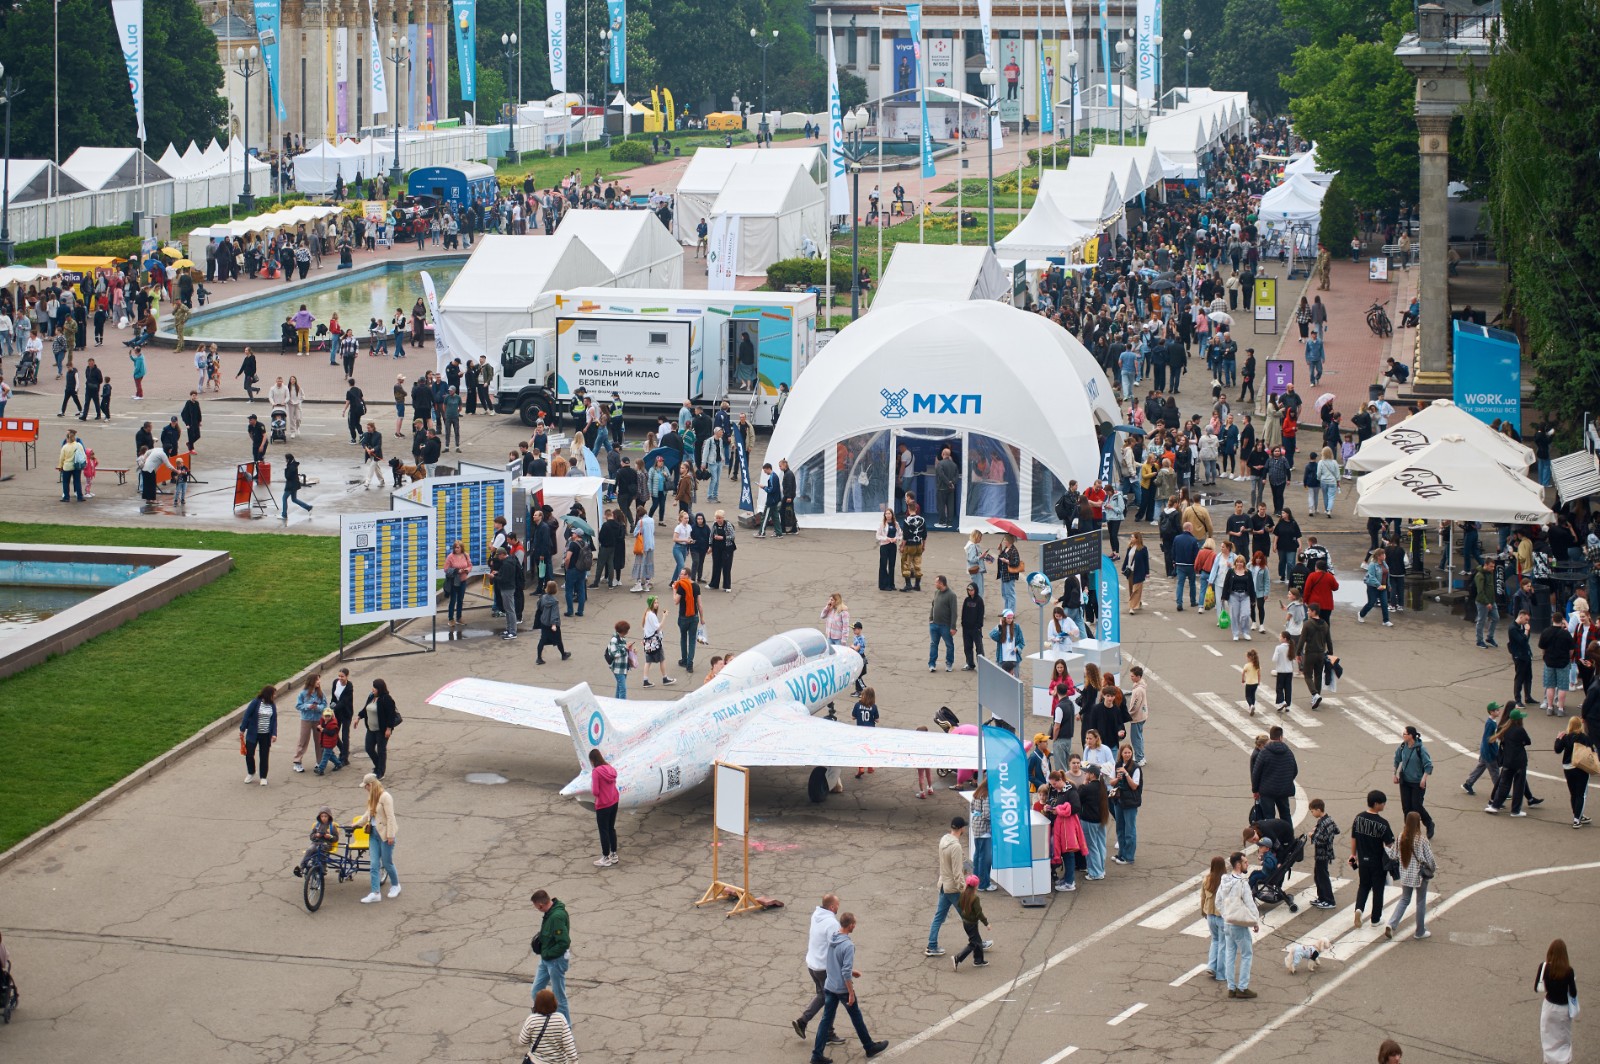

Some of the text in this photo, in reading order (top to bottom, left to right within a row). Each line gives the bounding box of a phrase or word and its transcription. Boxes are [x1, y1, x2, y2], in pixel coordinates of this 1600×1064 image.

[551, 12, 563, 74] WORK.ua
[1139, 15, 1151, 80] WORK.ua
[124, 24, 139, 113] ORK.ua
[578, 379, 619, 387] БЕЗПЕКИ
[579, 369, 660, 379] МОБІЛЬНИЙ КЛАС
[912, 393, 982, 414] МХП
[1464, 393, 1517, 405] WORK.ua
[785, 664, 851, 706] WORK.ua
[712, 685, 777, 723] ЛІТАК ДО МРІЙ
[860, 710, 870, 722] 10
